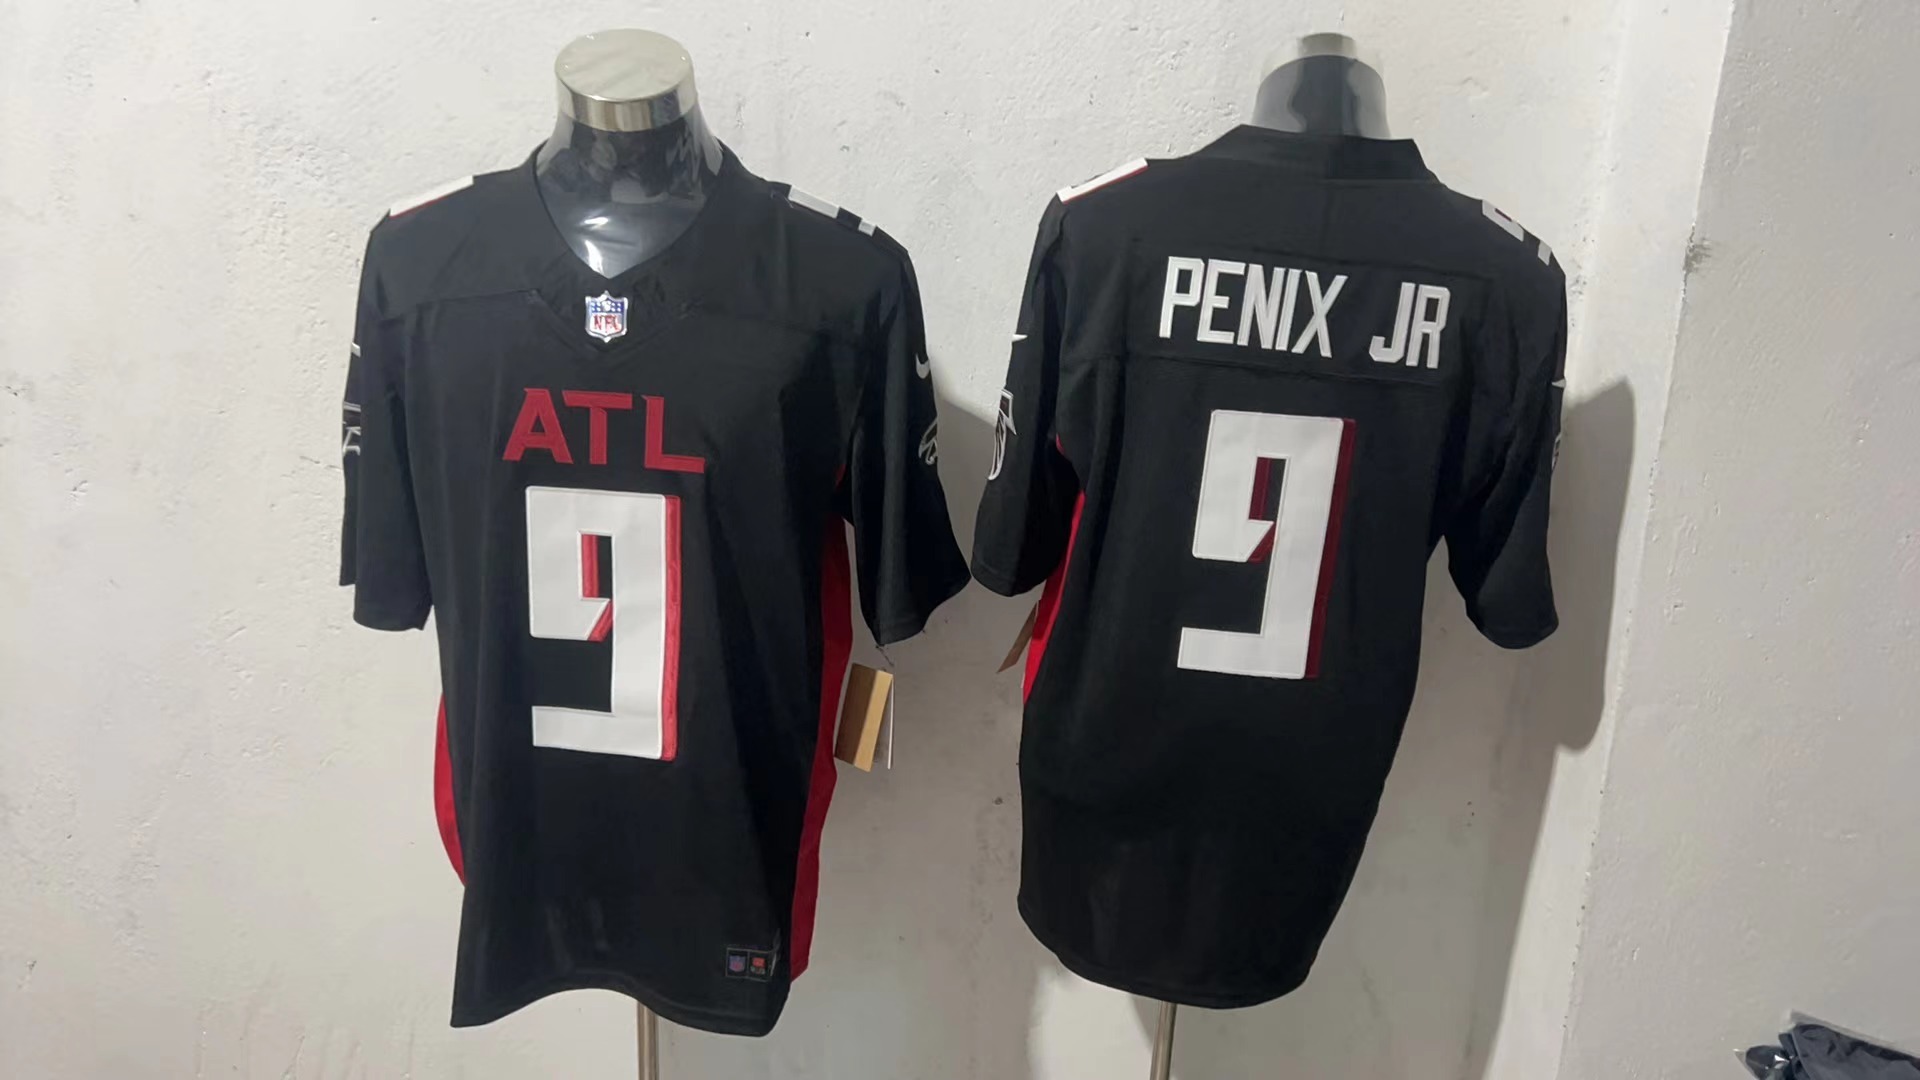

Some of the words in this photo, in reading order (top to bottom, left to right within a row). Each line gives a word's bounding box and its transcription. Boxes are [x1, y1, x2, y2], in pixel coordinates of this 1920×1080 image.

[593, 313, 621, 334] NFL
[1159, 256, 1348, 358] PENIX
[1368, 281, 1451, 369] JR
[502, 388, 706, 474] ATL
[1177, 409, 1356, 680] 9
[525, 485, 682, 762] 9
